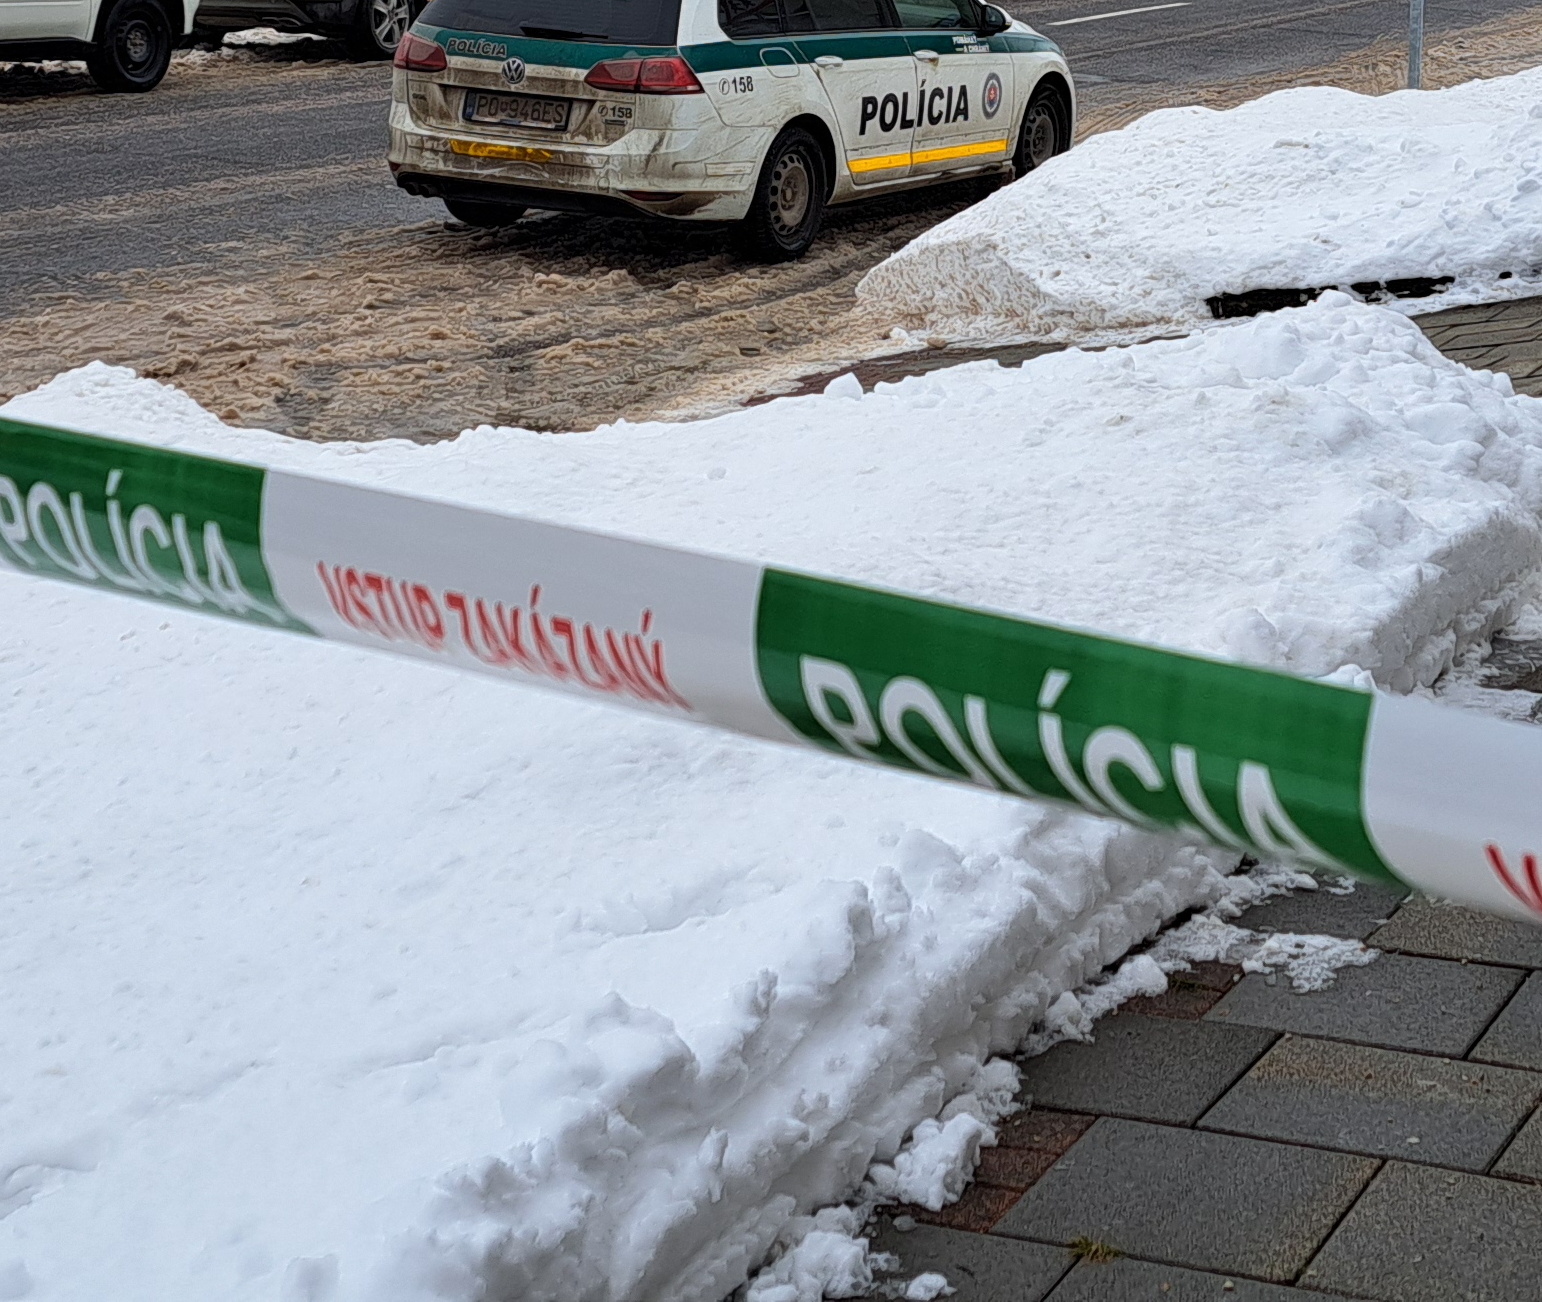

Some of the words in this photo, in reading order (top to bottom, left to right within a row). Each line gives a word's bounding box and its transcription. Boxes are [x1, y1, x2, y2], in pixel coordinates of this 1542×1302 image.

[446, 36, 508, 58] POLÍCIA
[731, 75, 754, 94] 158
[859, 78, 969, 135] POLÍCIA
